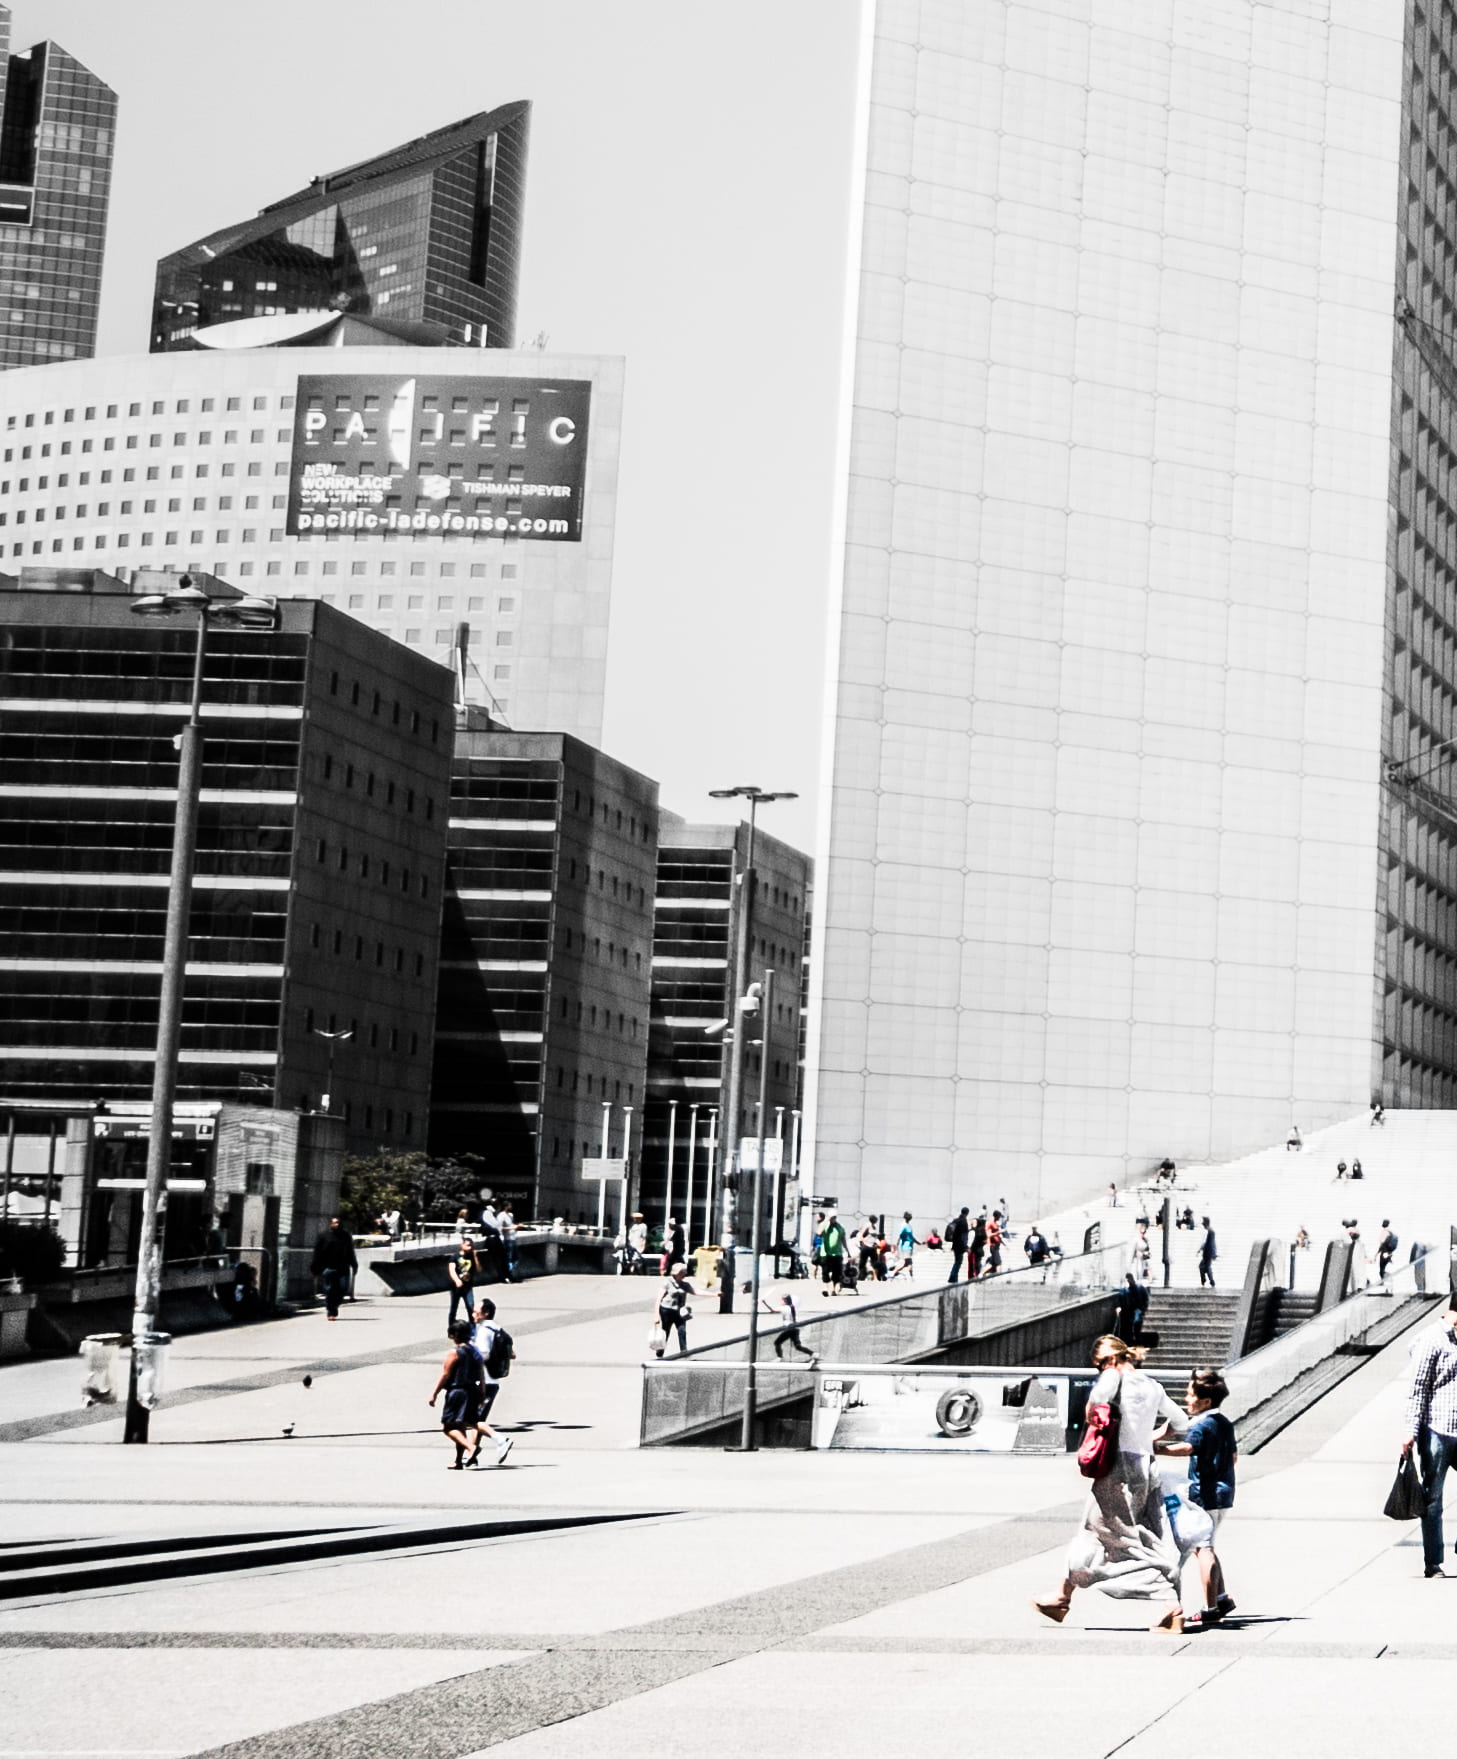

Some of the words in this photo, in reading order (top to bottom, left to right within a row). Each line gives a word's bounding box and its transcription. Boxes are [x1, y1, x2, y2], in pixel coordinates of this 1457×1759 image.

[304, 463, 338, 477] NEW
[301, 476, 393, 491] WORKPLACE
[462, 482, 520, 496] TISHMAN
[521, 484, 571, 497] SPEYER
[300, 489, 384, 504] SOLUTIONS
[298, 510, 569, 534] pacific-ladefense.com
